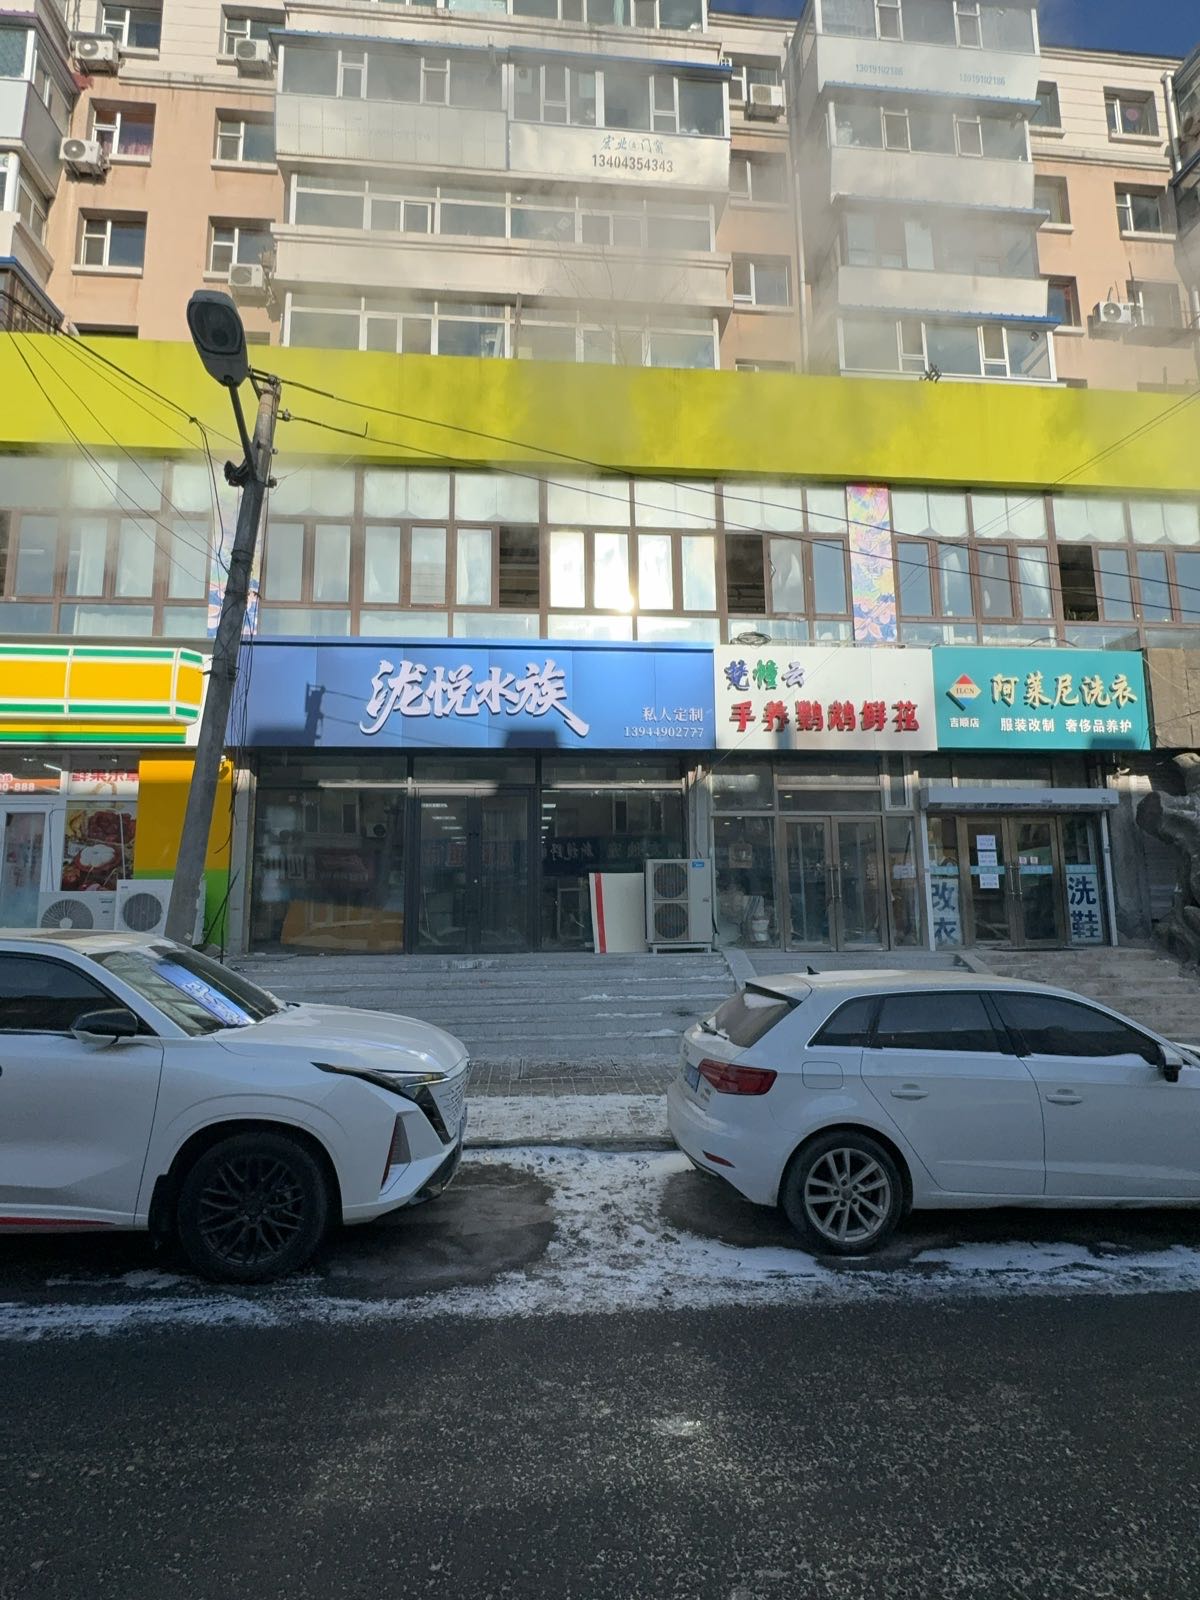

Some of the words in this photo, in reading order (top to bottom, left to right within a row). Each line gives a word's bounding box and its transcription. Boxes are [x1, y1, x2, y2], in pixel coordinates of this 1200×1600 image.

[592, 154, 674, 173] 13404354343
[990, 670, 1138, 710] 阿莱尼洗衣
[642, 706, 704, 722] 私人定制
[729, 700, 920, 733] 手养鹦鹉鲜花
[624, 726, 704, 737] 13944902777
[949, 717, 980, 729] 吉顺店
[1000, 717, 1055, 732] 服装改制
[1065, 719, 1132, 733] 奢侈品养护
[0, 782, 35, 793] 0-888
[931, 881, 959, 944] 改衣
[1068, 875, 1099, 938] 洗鞋
